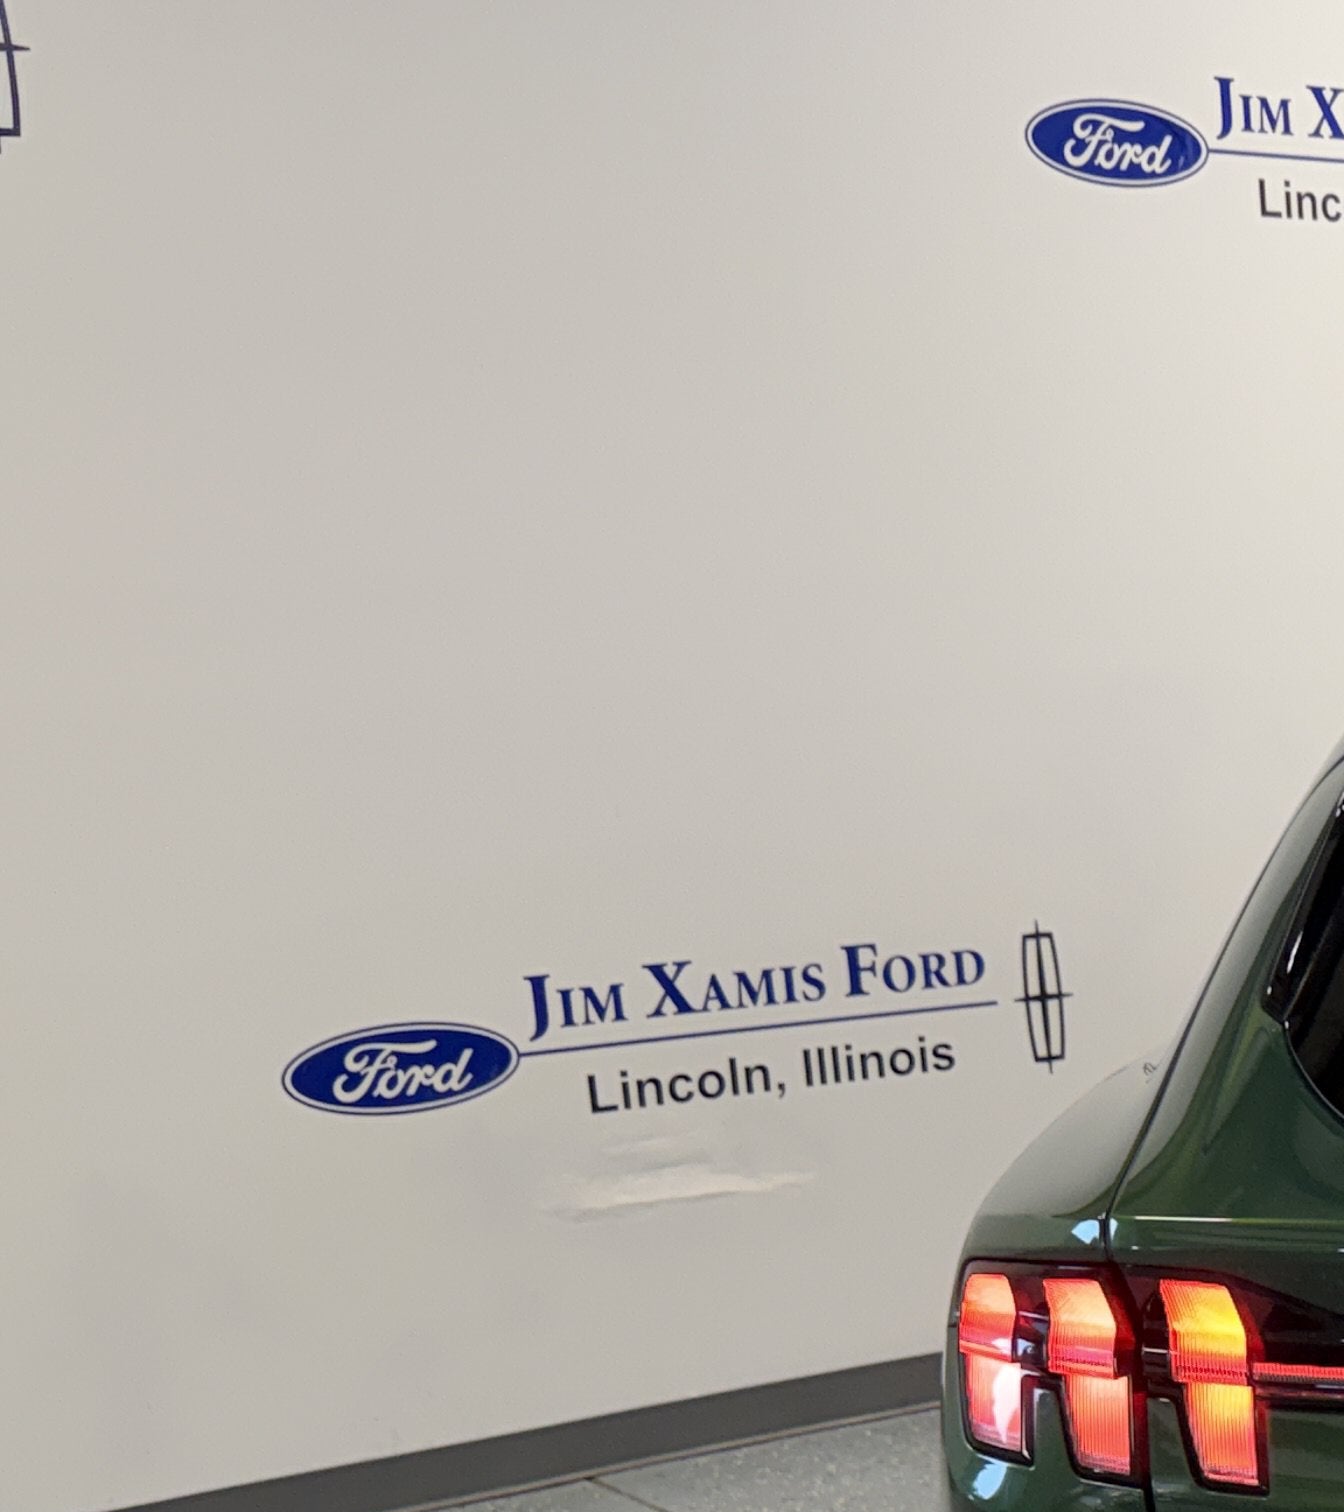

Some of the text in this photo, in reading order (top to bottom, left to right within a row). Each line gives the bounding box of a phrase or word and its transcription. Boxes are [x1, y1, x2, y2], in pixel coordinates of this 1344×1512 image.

[1214, 76, 1293, 140] JIM
[1062, 112, 1173, 176] Ford
[522, 943, 986, 1043] JIM XAMIS FORD
[331, 1039, 474, 1103] Ford
[586, 1035, 956, 1115] Lincoln, Illinois
